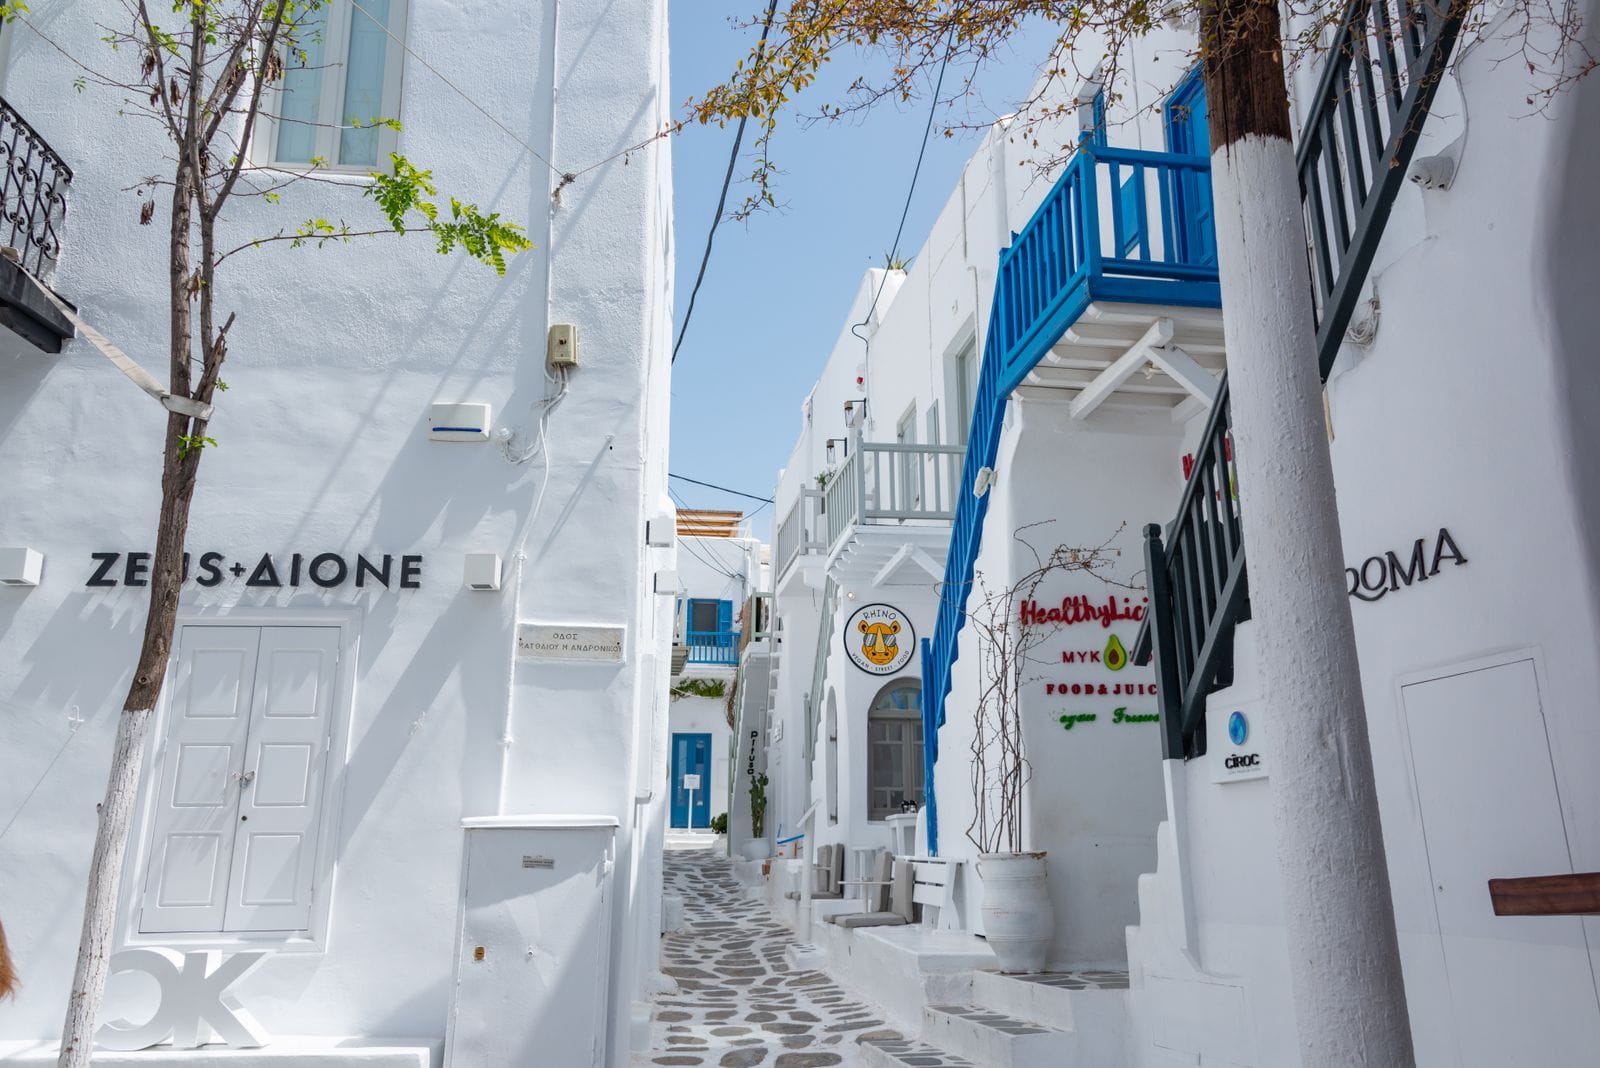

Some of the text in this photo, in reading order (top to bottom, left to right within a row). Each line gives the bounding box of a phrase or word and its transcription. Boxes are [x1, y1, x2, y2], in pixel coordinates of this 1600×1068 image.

[85, 552, 422, 588] ZES+ΔIONE
[863, 609, 897, 620] RHINO
[898, 650, 910, 665] FOOD
